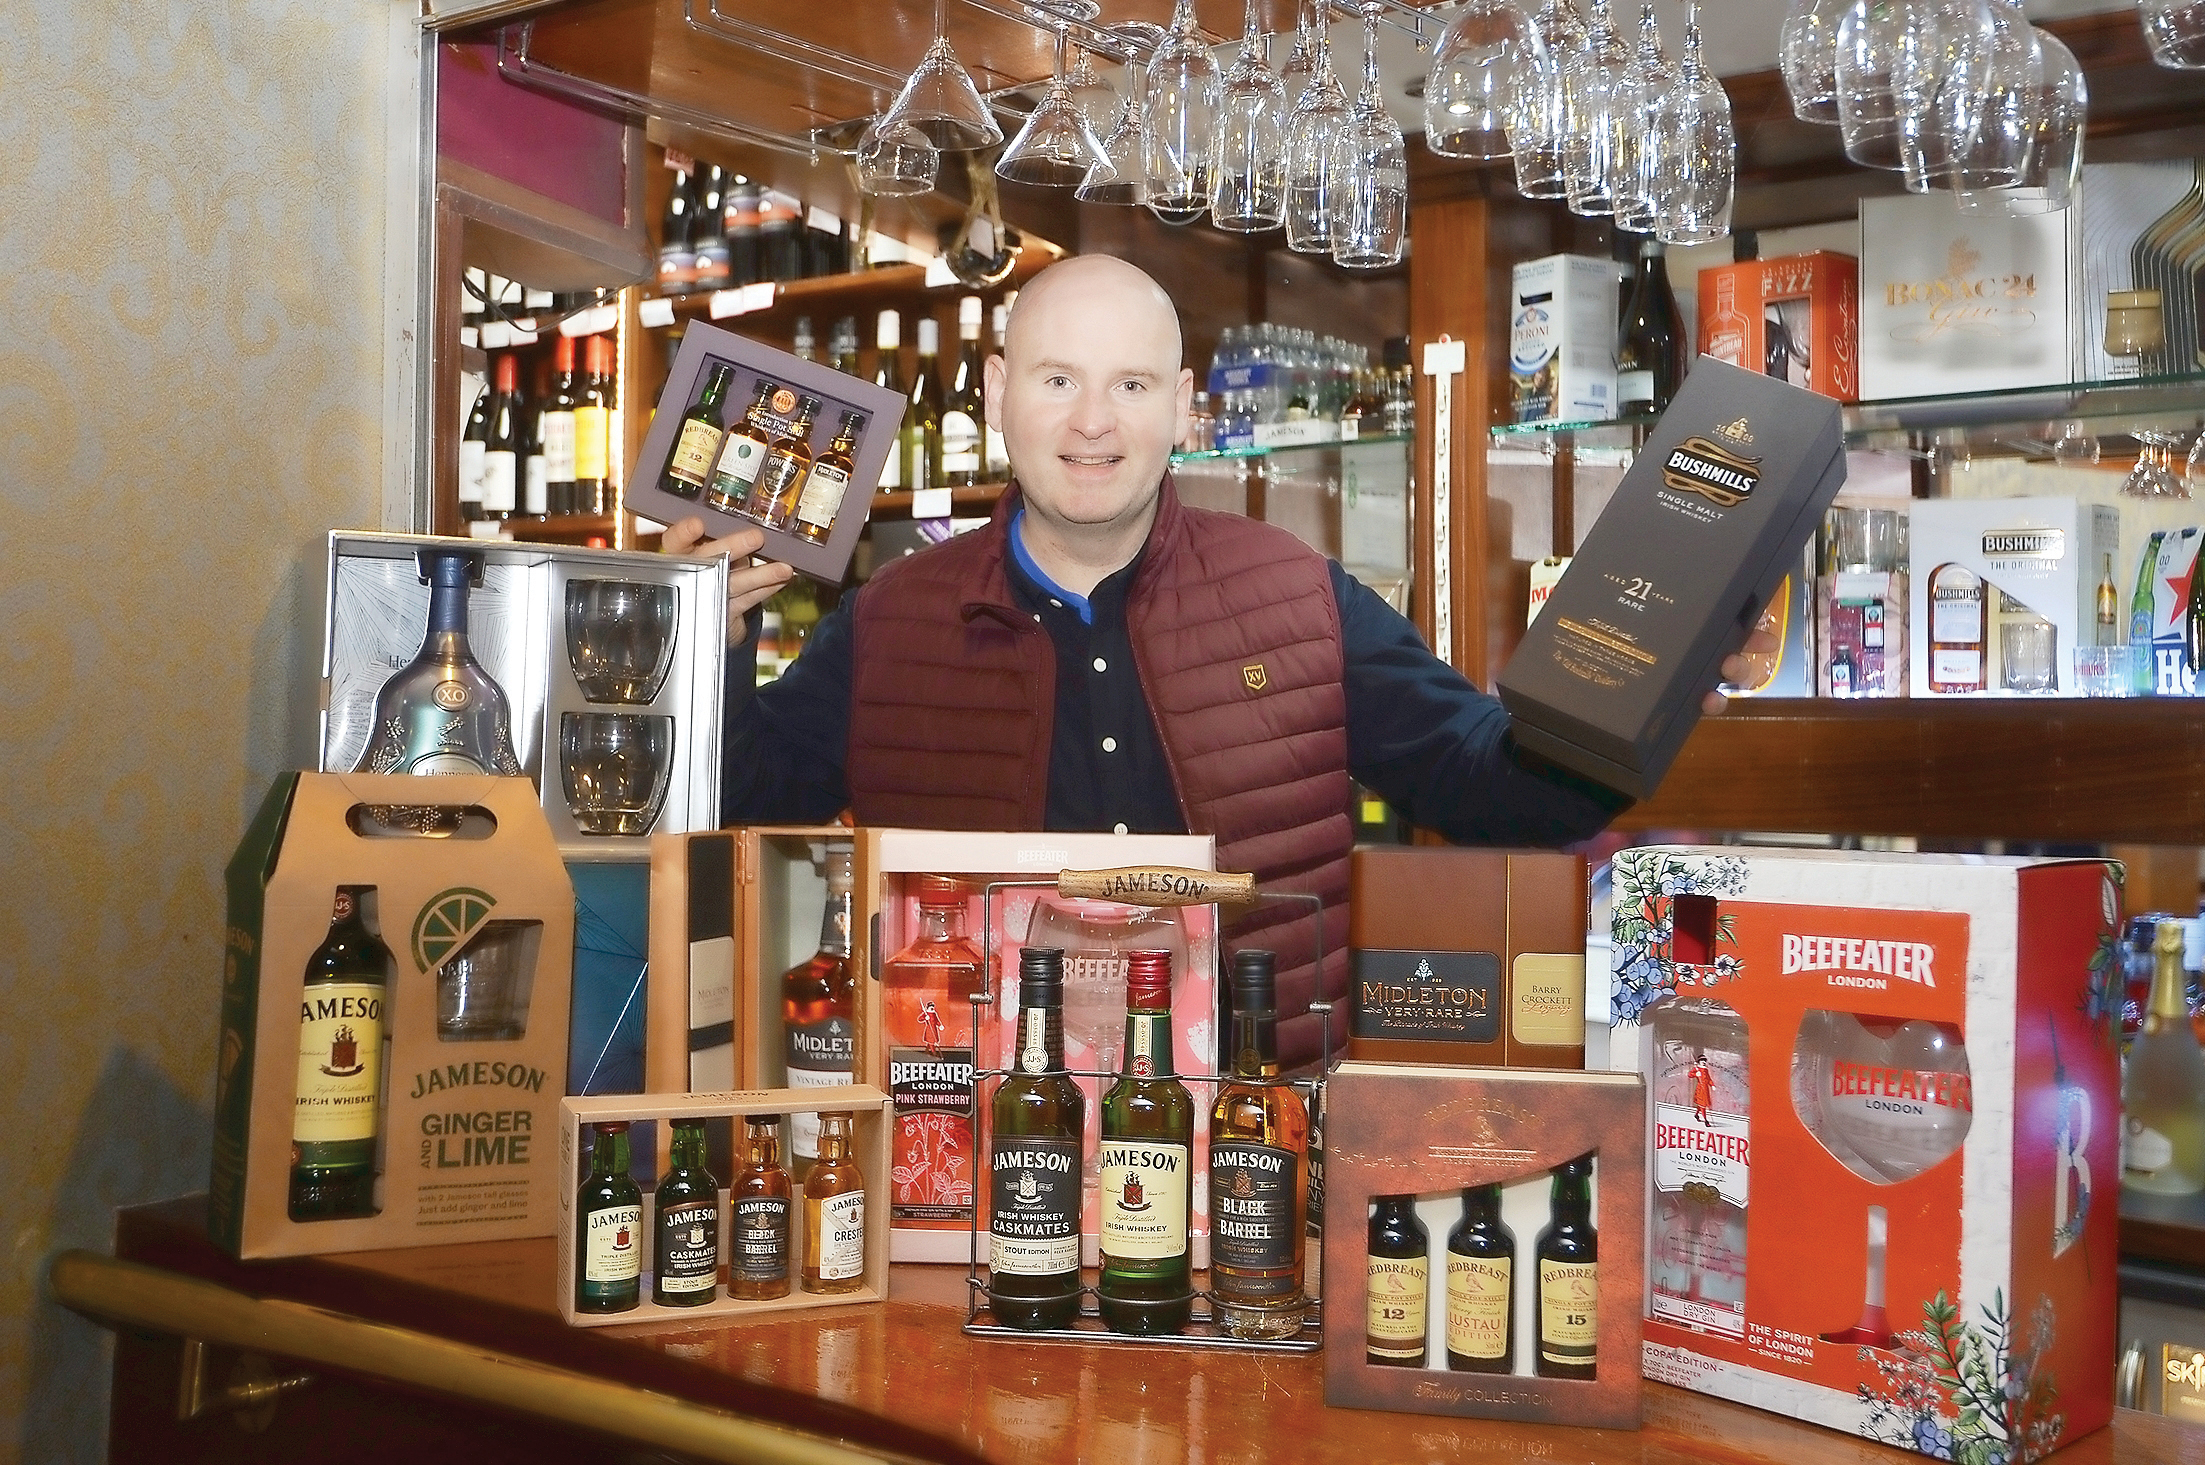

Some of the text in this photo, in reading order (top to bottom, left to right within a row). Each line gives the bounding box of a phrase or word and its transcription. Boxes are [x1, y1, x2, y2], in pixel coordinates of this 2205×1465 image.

[1668, 451, 1754, 492] BUSHMILLS
[1656, 491, 1724, 519] SINGLE MALT
[1659, 501, 1712, 523] IRISH WHISKEY
[1624, 576, 1653, 600] 21
[1617, 596, 1646, 612] RARE
[1102, 872, 1204, 900] JAMESON
[1782, 933, 1937, 988] BEEFEATER
[1063, 958, 1129, 983] BEEFEA
[1532, 985, 1562, 994] BARRY
[1827, 974, 1888, 990] LONDON
[1362, 981, 1487, 1010] MIDLETON
[1521, 995, 1573, 1005] CROCKETT
[300, 997, 382, 1023] AMESO
[793, 1032, 854, 1052] MIDLET
[410, 1061, 546, 1099] JAMESON
[890, 1061, 974, 1086] BEEFEATER
[912, 1082, 955, 1091] LONDON
[1833, 1059, 1972, 1113] BEEFEATER
[895, 1093, 971, 1105] PINK STRAWBERRY
[1865, 1099, 1923, 1115] LONDON
[421, 1110, 532, 1136] GINGER
[437, 1135, 531, 1169] LIME
[1656, 1122, 1750, 1166] BEEFEATER
[421, 1139, 432, 1169] AND
[993, 1151, 1072, 1174] JAMESON
[1100, 1150, 1179, 1173] JAMESON
[1212, 1151, 1283, 1174] JAMESON
[1679, 1151, 1727, 1167] LONDON
[418, 1200, 528, 1214] Just add ginger and lime
[738, 1202, 785, 1215] JAMESON
[997, 1210, 1065, 1221] IRISH WHISKEY
[1223, 1197, 1266, 1217] BLACK
[591, 1210, 641, 1229] JAMESO
[993, 1219, 1070, 1236] CASKMATES
[1105, 1221, 1124, 1231] IRISH
[834, 1227, 863, 1242] CRESTE
[1220, 1219, 1272, 1240] BARREL
[1004, 1246, 1027, 1255] STOUT
[1543, 1268, 1597, 1283] REDBREA
[1382, 1308, 1405, 1320] 12
[1566, 1314, 1587, 1325] 15
[1683, 1303, 1716, 1317] LONDON
[1683, 1310, 1716, 1324] DRY GIN
[1449, 1311, 1500, 1331] LUSTAU
[1449, 1323, 1501, 1340] EDITION
[1749, 1322, 1814, 1346] THE SPIRIT
[1748, 1334, 1814, 1358] OF LONDON
[1758, 1348, 1782, 1361] SINCE
[1646, 1346, 1718, 1372] COPA EDITION
[1665, 1370, 1679, 1379] DRY
[1667, 1364, 1702, 1378] BEEFEATER
[1464, 1389, 1554, 1406] COLLECTION
